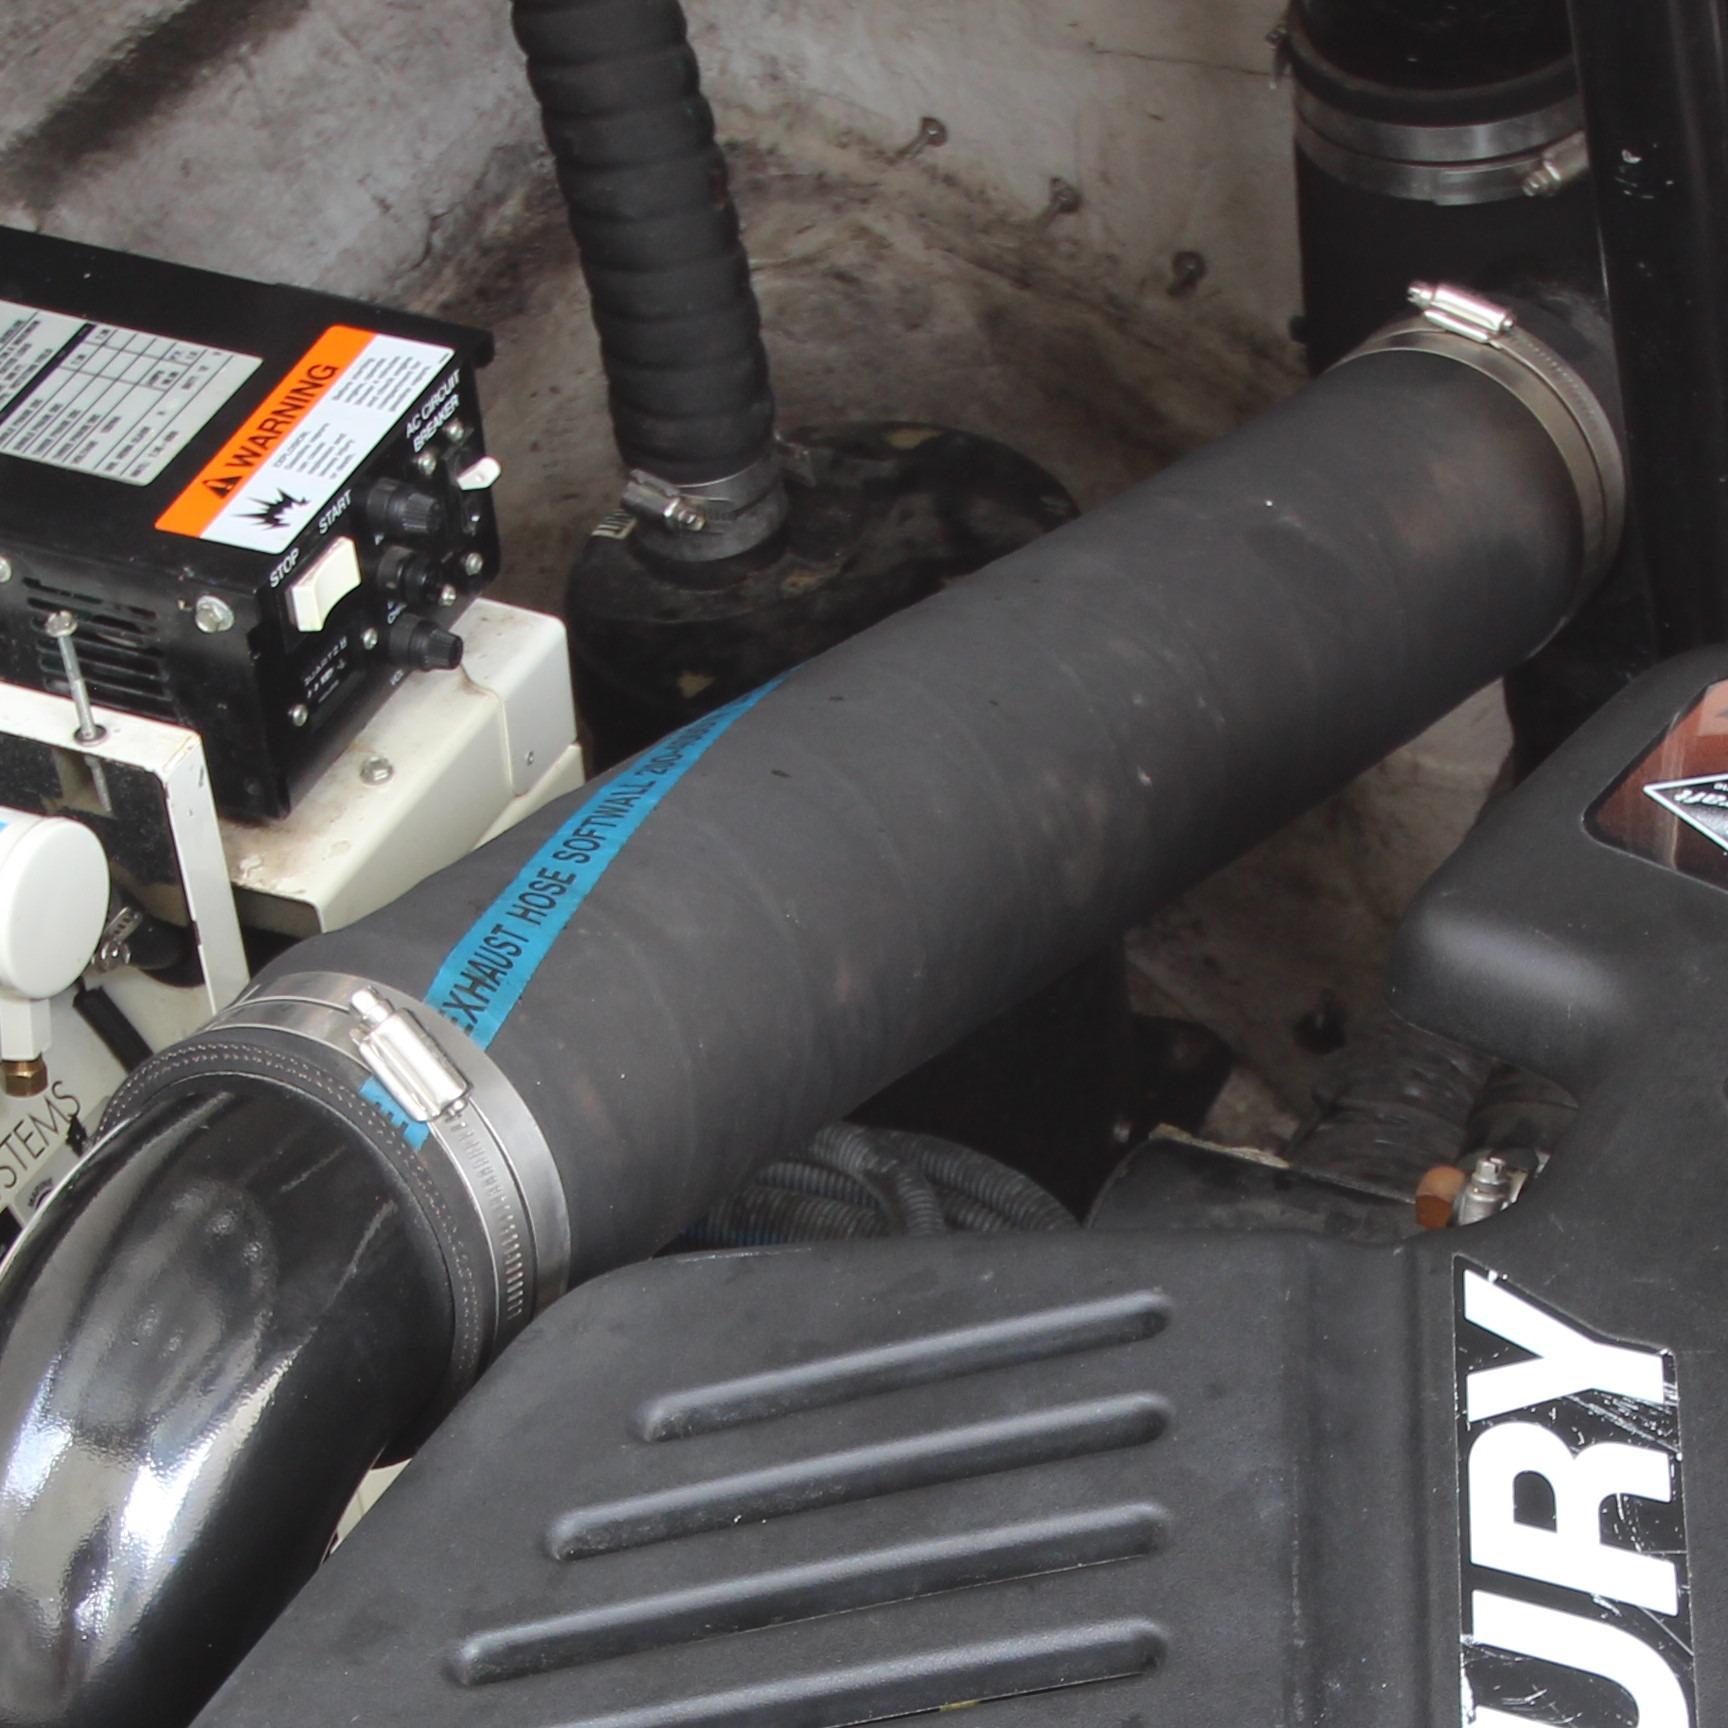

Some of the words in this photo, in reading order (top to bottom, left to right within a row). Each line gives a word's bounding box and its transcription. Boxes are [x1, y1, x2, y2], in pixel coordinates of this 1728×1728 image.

[222, 362, 341, 470] WARNING
[406, 416, 422, 437] AC
[421, 369, 461, 419] CIRCUIT
[413, 394, 460, 452] BREAKER
[319, 489, 352, 534] START
[270, 548, 299, 588] STOP
[437, 924, 529, 1036] EXHAUST
[507, 867, 576, 926] HOSE
[553, 780, 655, 864] SOFTWALL
